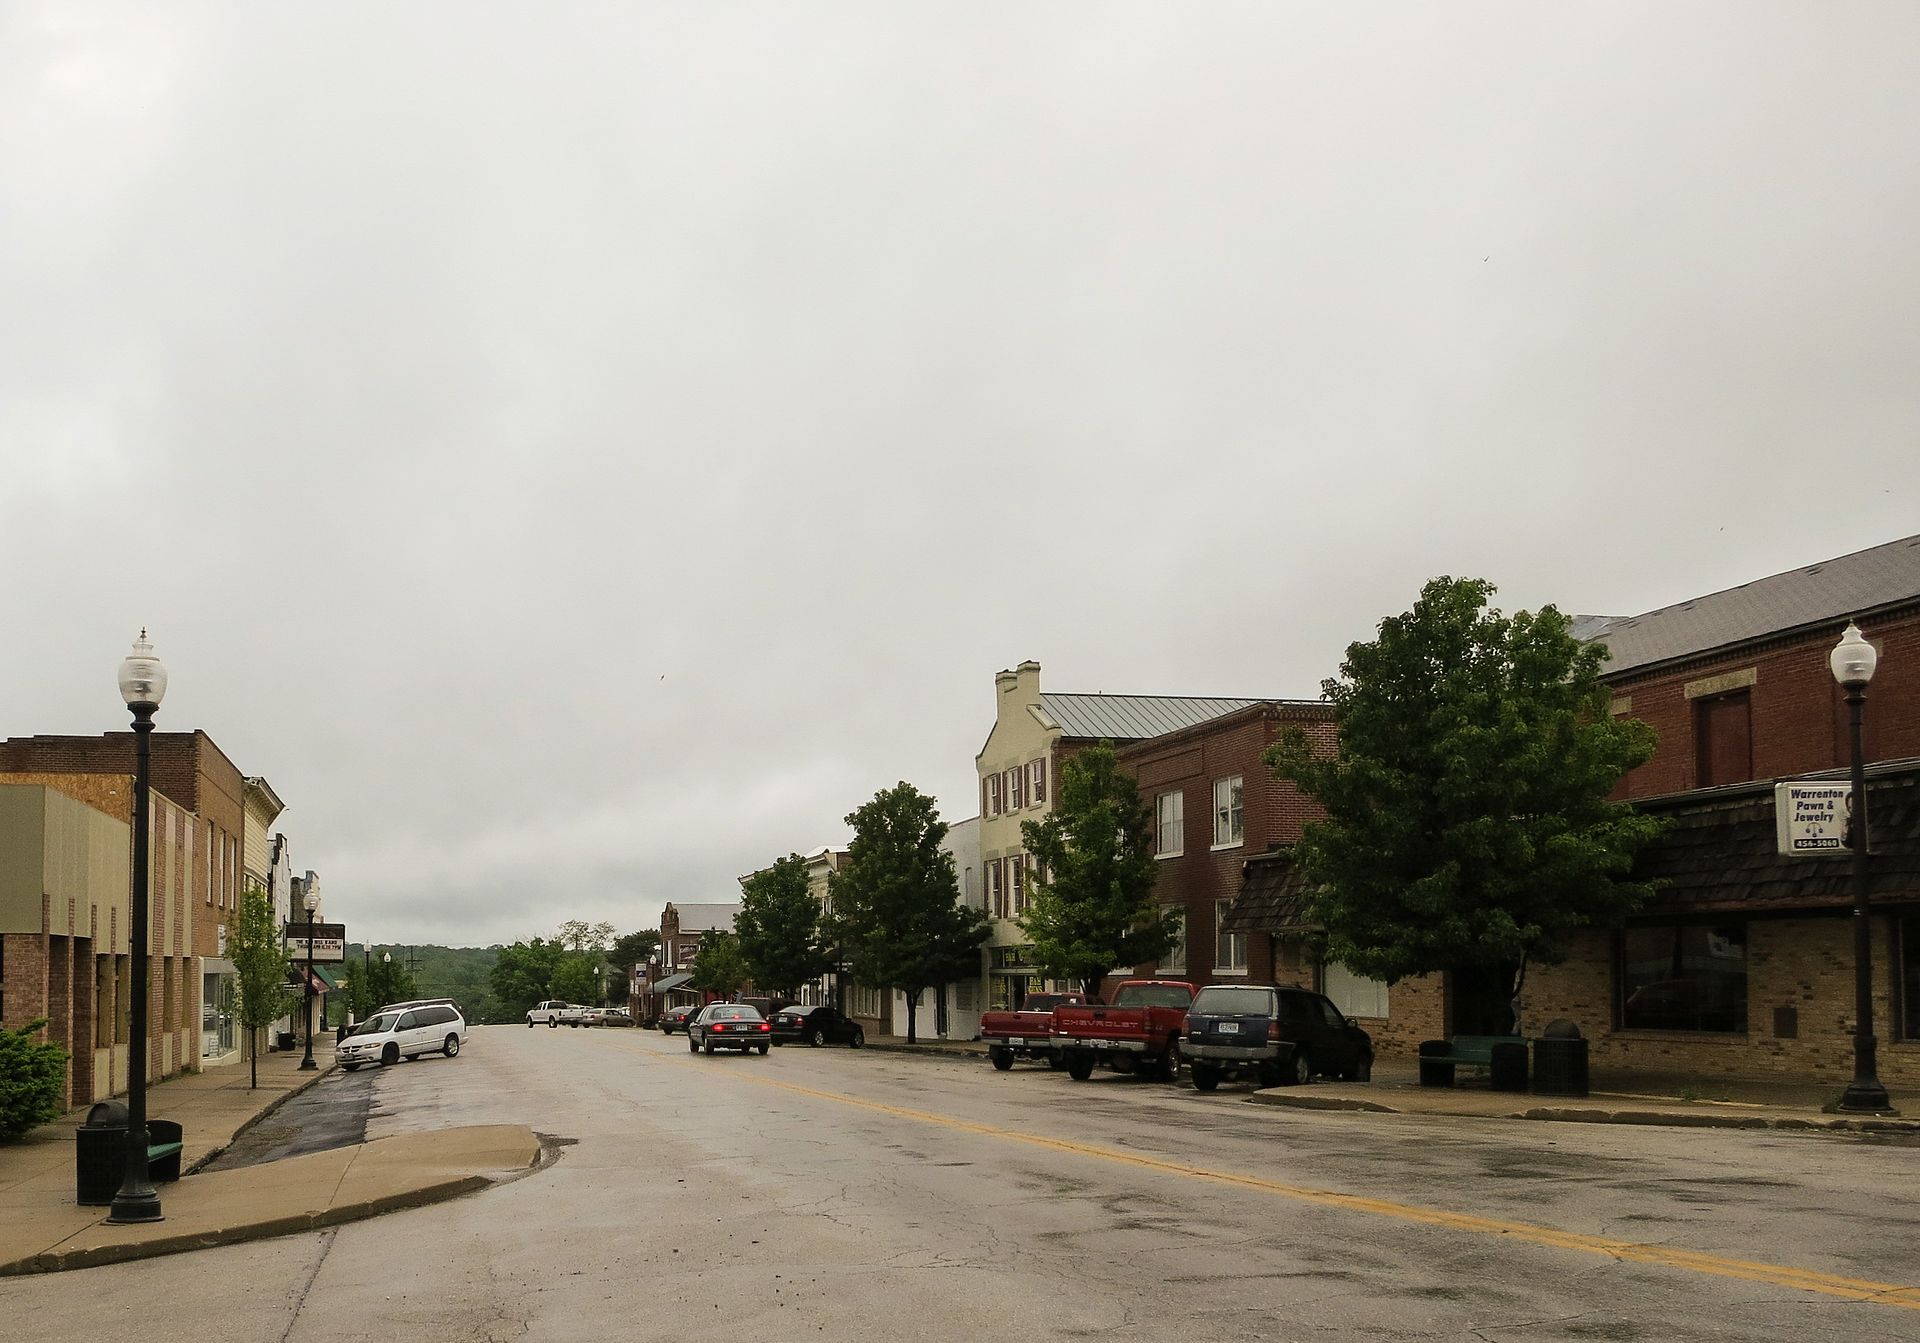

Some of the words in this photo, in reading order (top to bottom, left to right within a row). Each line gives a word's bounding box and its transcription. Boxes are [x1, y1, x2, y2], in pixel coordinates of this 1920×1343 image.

[1790, 789, 1844, 799] Warrenton
[1796, 801, 1824, 811] Pawn
[1826, 800, 1834, 810] &
[1794, 811, 1834, 823] Jewelry
[1062, 1019, 1139, 1029] CHEVROLET
